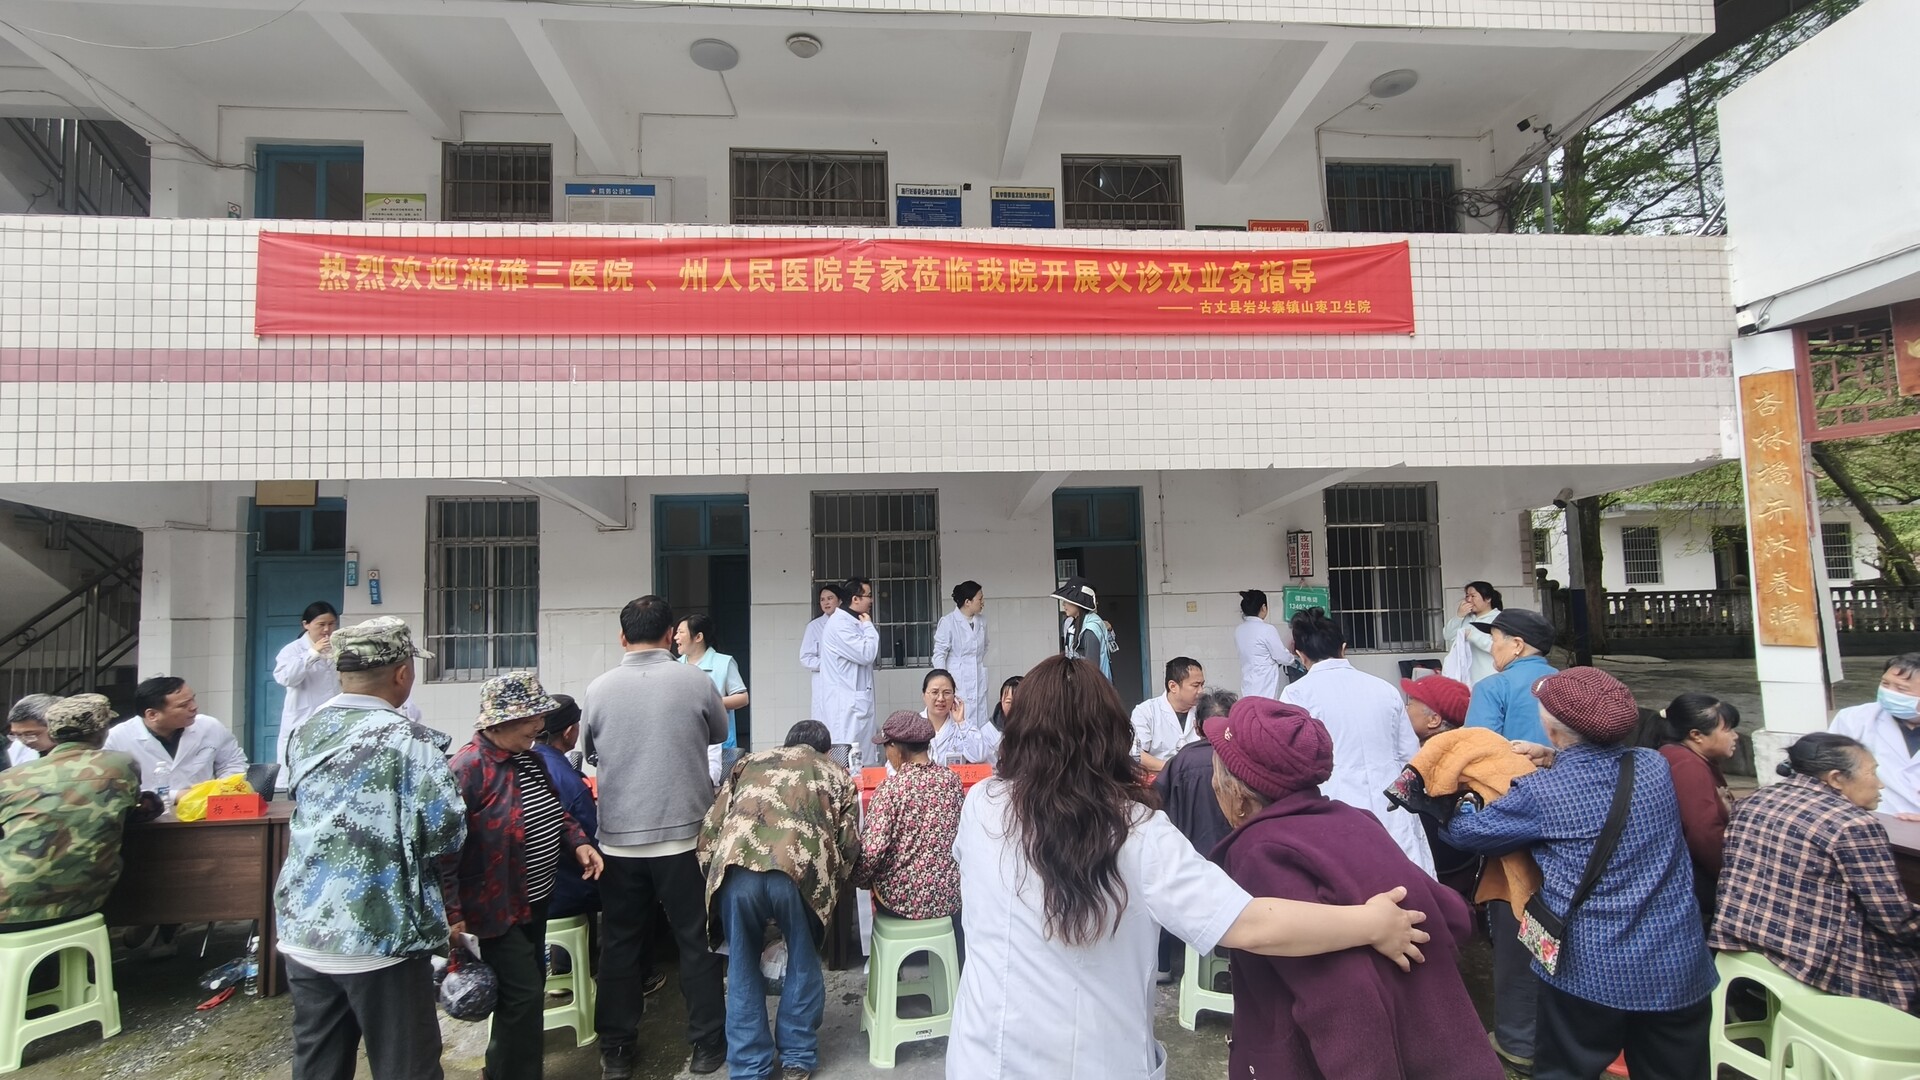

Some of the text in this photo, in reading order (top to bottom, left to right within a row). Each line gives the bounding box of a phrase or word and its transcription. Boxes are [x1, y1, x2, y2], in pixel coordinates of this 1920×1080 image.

[318, 252, 1317, 294] 热烈欢迎湘雅三医院、州人民医院专家莅临我院开展义诊及业务指导
